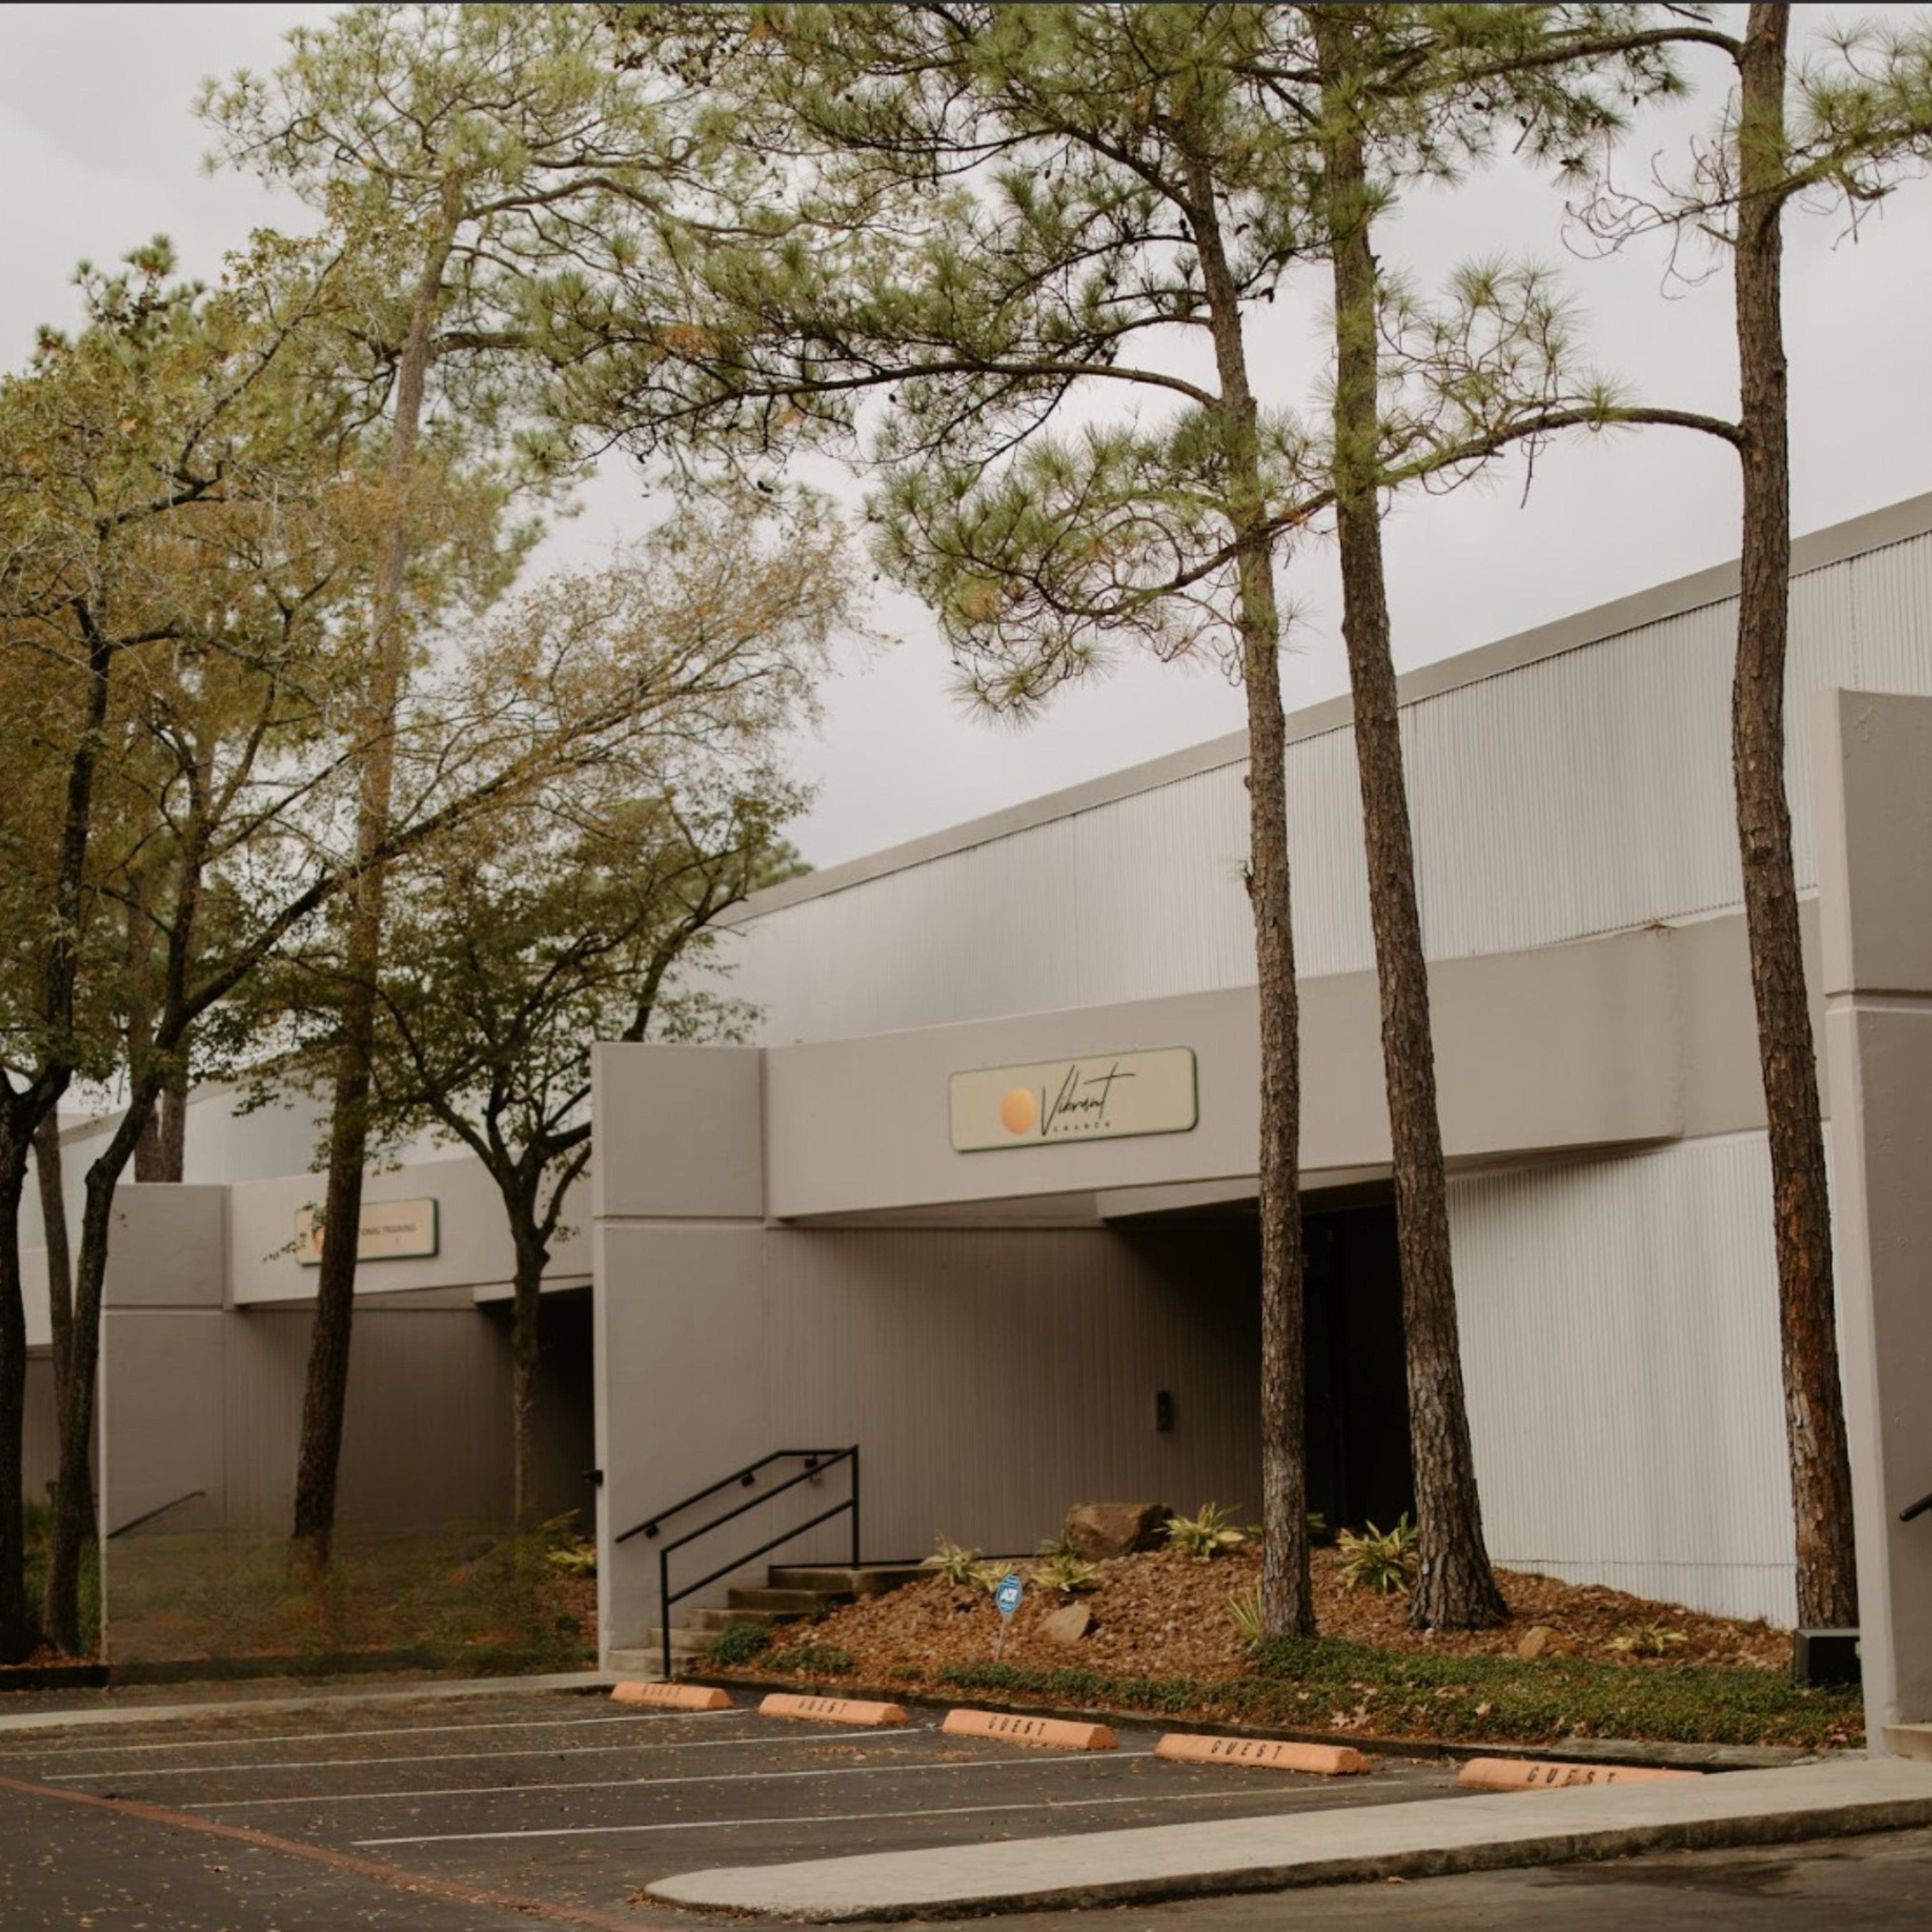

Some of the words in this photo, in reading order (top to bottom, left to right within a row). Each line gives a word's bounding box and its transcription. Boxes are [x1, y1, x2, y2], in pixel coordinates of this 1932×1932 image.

[1041, 1062, 1136, 1136] Vibrant
[798, 1700, 847, 1714] GUEST
[988, 1716, 1045, 1736] GUEST
[1211, 1740, 1282, 1760] GUEST
[1527, 1766, 1616, 1785] GUEST
